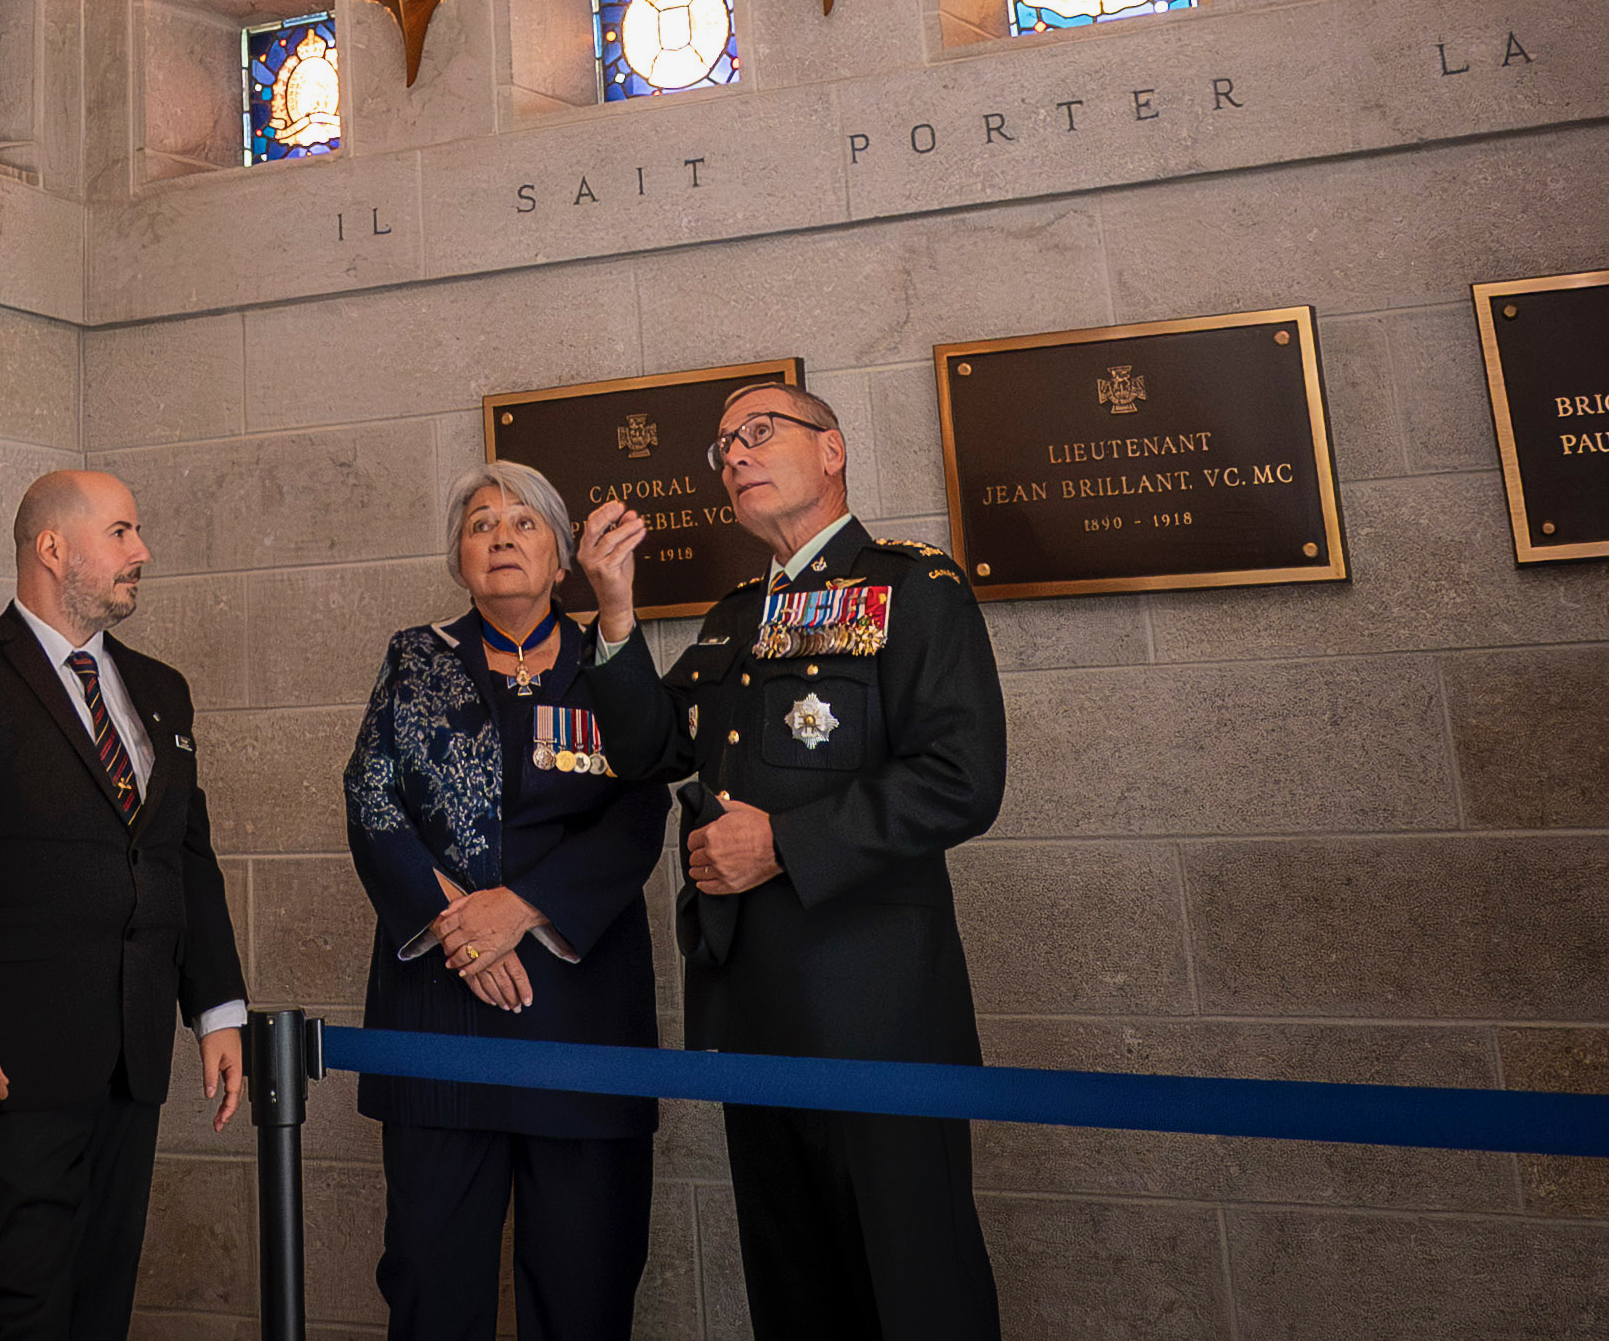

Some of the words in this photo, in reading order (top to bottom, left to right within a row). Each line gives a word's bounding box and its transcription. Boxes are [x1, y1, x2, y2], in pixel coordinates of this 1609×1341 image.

[336, 207, 394, 243] IL
[515, 156, 710, 216] SAIT
[846, 75, 1246, 166] PORTER
[1436, 30, 1536, 78] LA
[1554, 393, 1609, 418] BRI
[1047, 431, 1213, 465] LIEUTENANT
[589, 476, 697, 504] CAPORAL
[981, 481, 1049, 506] JEAN
[1252, 462, 1295, 485] MC
[1083, 515, 1124, 533] 1890
[1152, 511, 1194, 529] 1918
[660, 547, 694, 562] 1918
